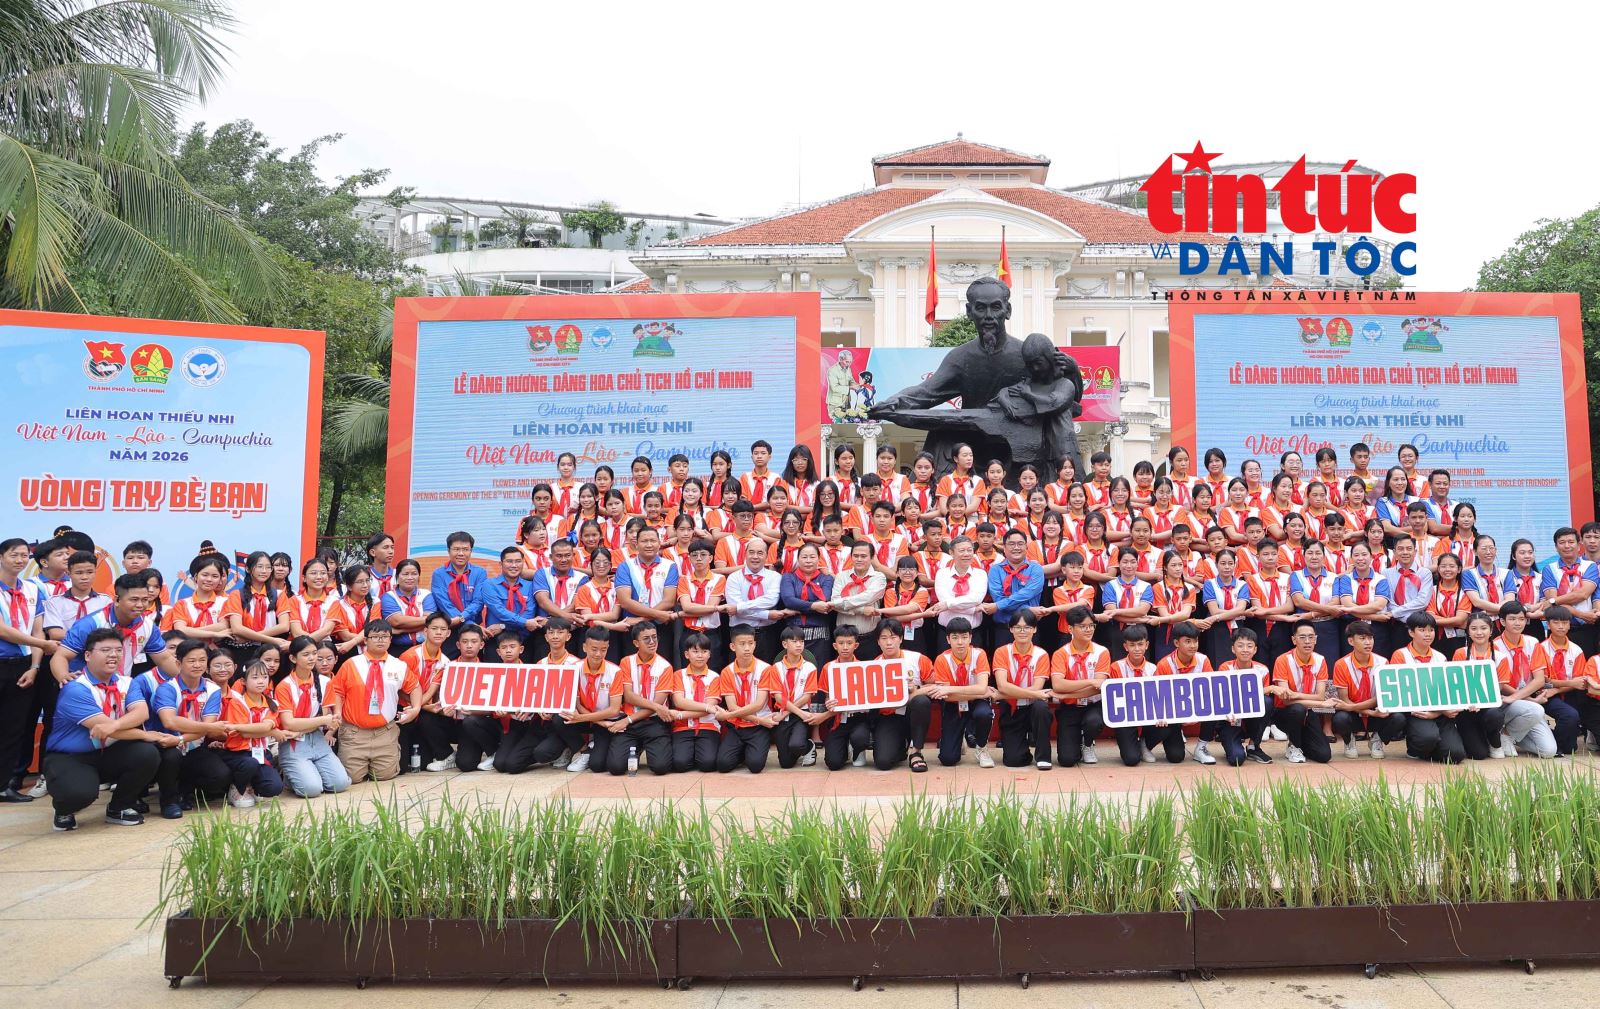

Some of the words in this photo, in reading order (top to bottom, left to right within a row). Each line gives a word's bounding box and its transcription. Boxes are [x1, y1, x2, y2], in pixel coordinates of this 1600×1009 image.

[469, 374, 503, 393] DÂNG
[553, 372, 587, 392] DÂNG
[589, 374, 614, 391] HOA
[617, 368, 642, 390] CHỦ
[645, 372, 672, 394] TỊCH
[675, 367, 691, 389] HỒ
[694, 369, 715, 389] CHÍ
[718, 371, 753, 389] MINH
[1244, 364, 1278, 384] DÂNG
[1327, 364, 1360, 384] DÂNG
[1362, 367, 1387, 384] HOA
[1389, 362, 1413, 384] CHỦ
[1415, 367, 1442, 389] TỊCH
[1444, 362, 1461, 384] HỒ
[1463, 364, 1483, 384] CHÍ
[1485, 367, 1518, 384] MINH
[66, 407, 102, 419] LIÊN
[107, 410, 154, 421] HOAN
[158, 410, 204, 423] THIẾU
[208, 414, 235, 424] NHI
[512, 421, 549, 436] LIÊN
[555, 422, 603, 435] HOAN
[608, 417, 658, 434] THIẾU
[663, 420, 693, 433] NHI
[1291, 413, 1327, 427] LIÊN
[1332, 415, 1379, 427] HOAN
[1383, 411, 1432, 427] THIẾU
[1436, 415, 1464, 426] NHI
[17, 422, 58, 442] Việt
[61, 423, 107, 442] Nam
[125, 425, 165, 445] Lào
[182, 427, 273, 451] Campuchia
[1245, 433, 1284, 458] Việt
[1288, 433, 1335, 455] Nam
[1410, 433, 1511, 460] Campuchia
[110, 447, 147, 460] NĂM
[152, 451, 189, 461] 2026
[466, 443, 506, 469] Việt
[509, 442, 556, 465] Nam
[575, 440, 619, 465] Lào
[1473, 468, 1484, 476] AND
[19, 474, 106, 511] VÒNG
[110, 480, 166, 511] TAY
[169, 475, 207, 511] BÈ
[209, 481, 268, 518] BẠN
[444, 666, 575, 709] VIETNAM
[833, 662, 904, 707] LAOS
[1106, 673, 1261, 723] CAMBODIA
[1379, 664, 1497, 708] SAMAKI
